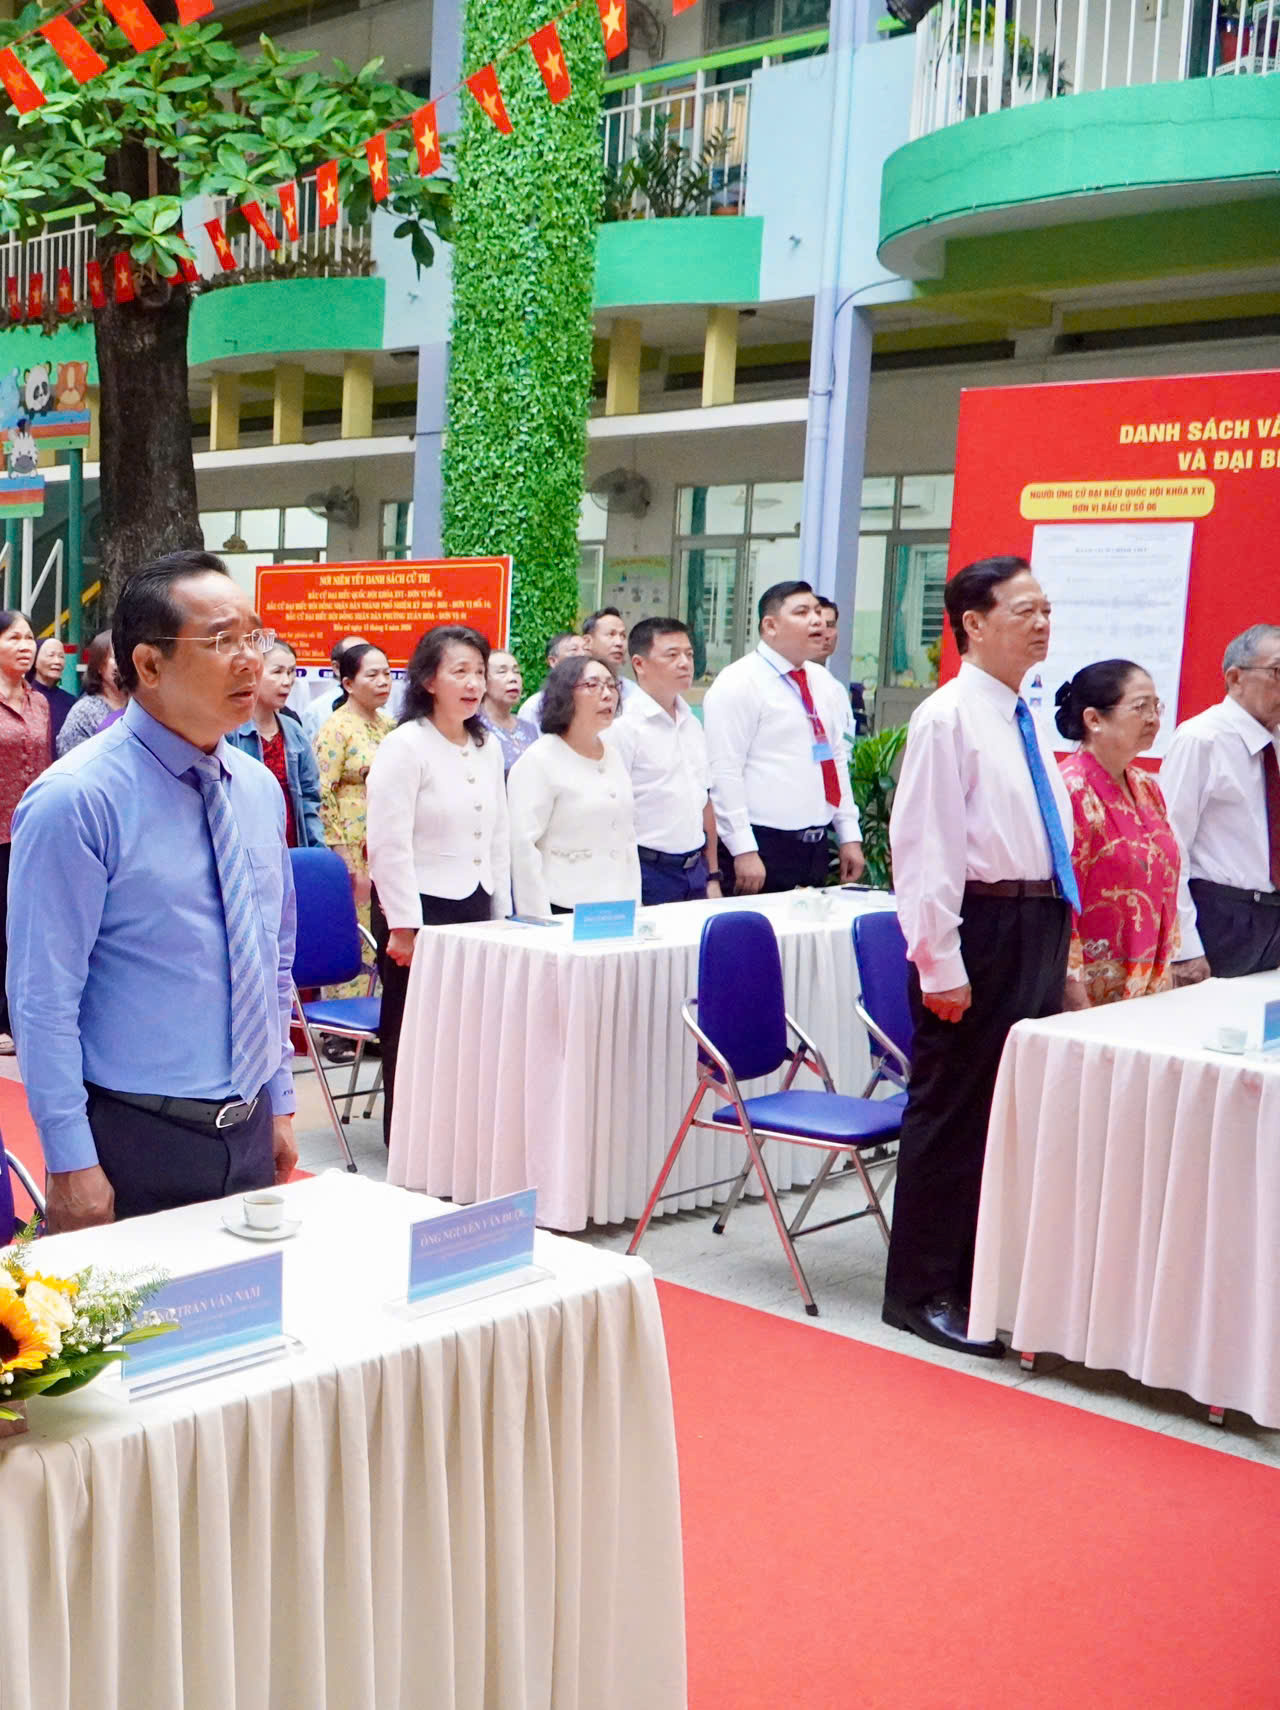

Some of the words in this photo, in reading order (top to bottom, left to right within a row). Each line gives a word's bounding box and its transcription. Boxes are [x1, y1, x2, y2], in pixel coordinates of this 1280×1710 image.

[1119, 422, 1181, 444] DANH
[1186, 416, 1250, 441] SÁCH
[1178, 447, 1207, 472] VÀ
[1213, 449, 1254, 473] ĐẠI
[1191, 487, 1206, 496] XVI
